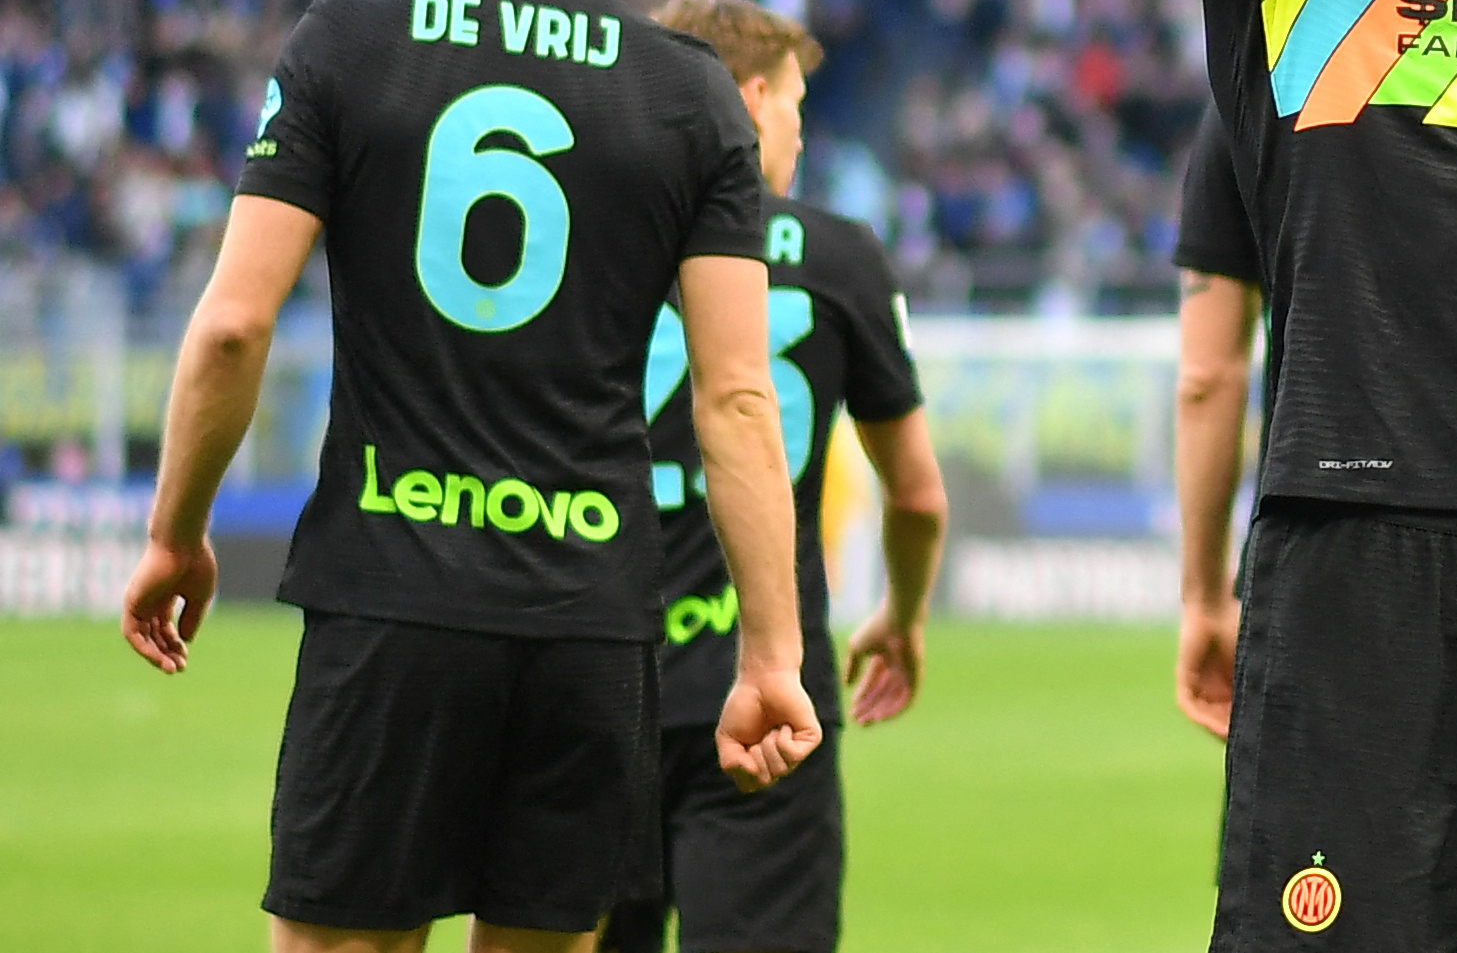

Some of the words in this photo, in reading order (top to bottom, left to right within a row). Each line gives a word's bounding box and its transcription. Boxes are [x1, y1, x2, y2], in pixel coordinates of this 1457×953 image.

[500, 0, 622, 69] VRIJ
[414, 83, 576, 333] 6
[359, 445, 622, 543] Lenovo
